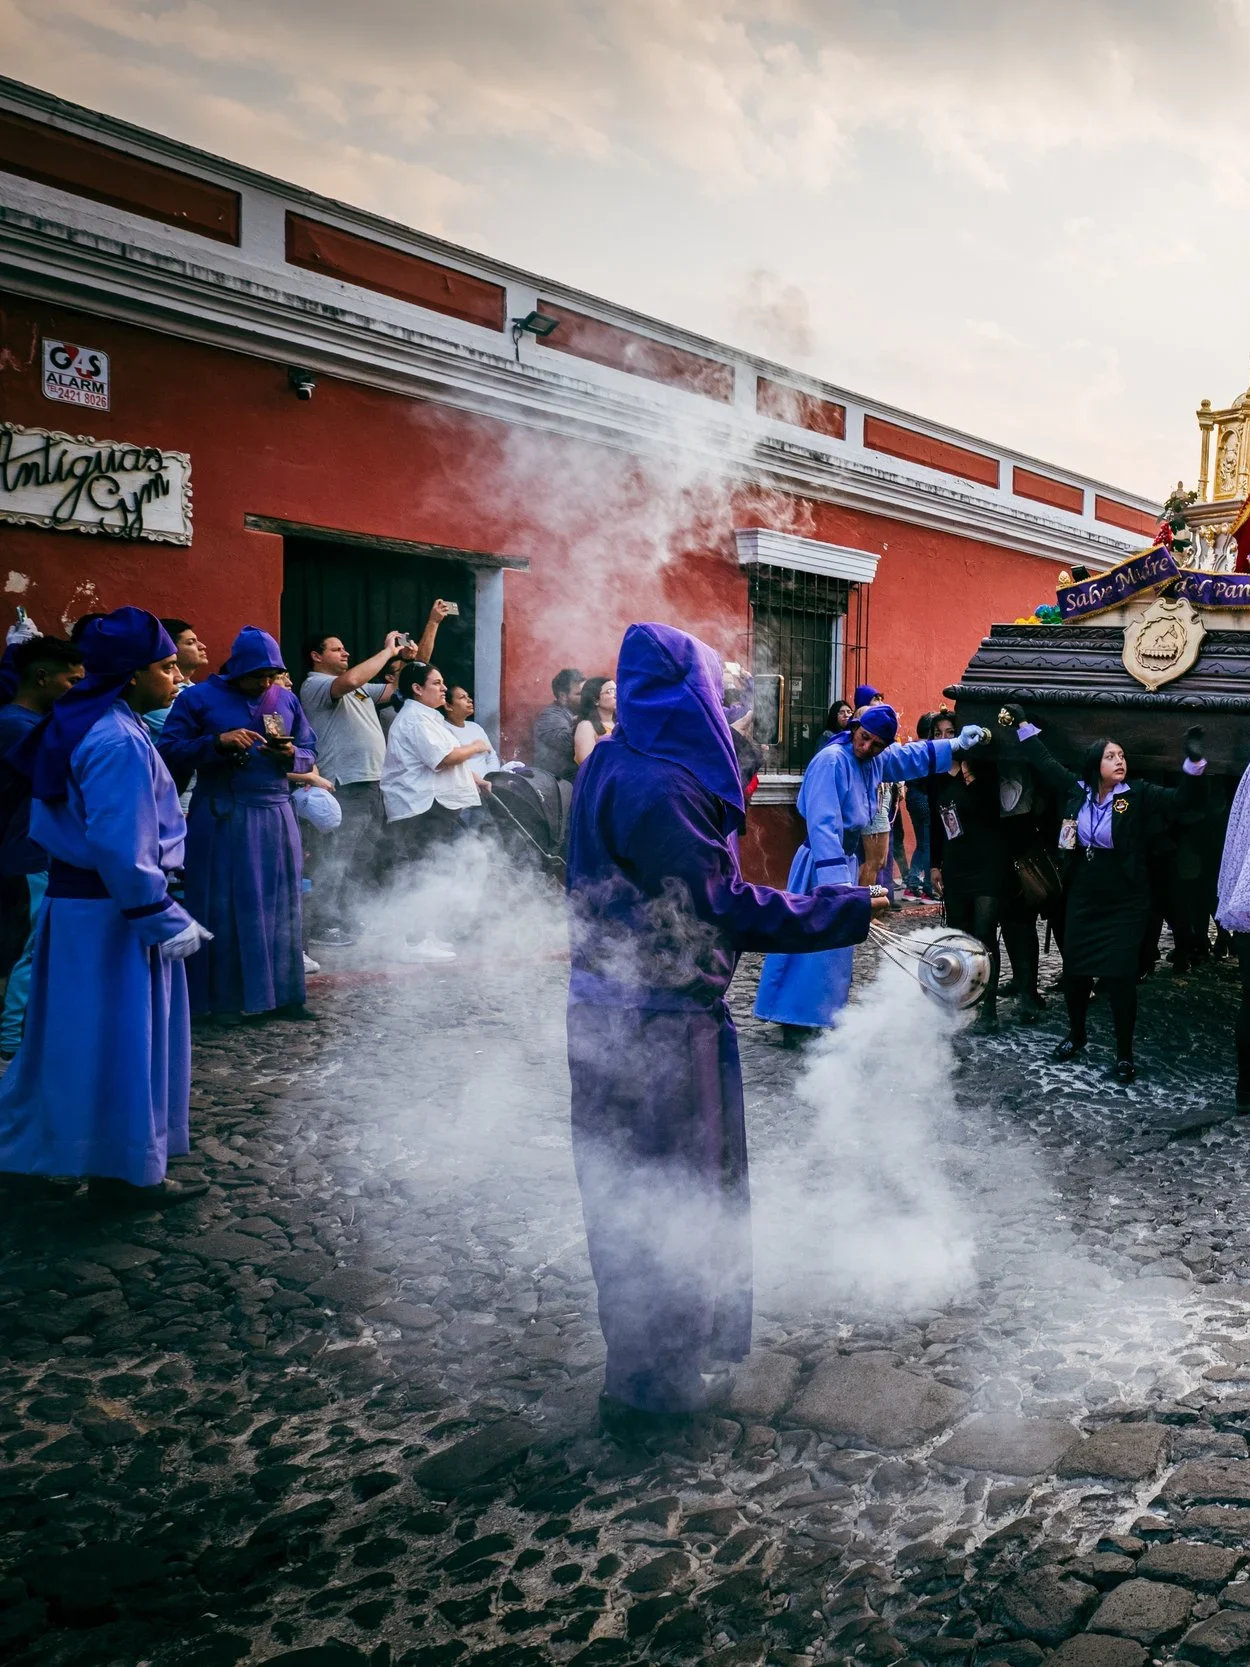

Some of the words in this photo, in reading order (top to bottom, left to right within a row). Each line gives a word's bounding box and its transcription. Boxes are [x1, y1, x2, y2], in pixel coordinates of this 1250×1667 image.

[47, 373, 104, 394] ALARM
[58, 388, 81, 402] 2421
[84, 393, 107, 407] 8026
[87, 472, 169, 538] Gym
[1066, 584, 1113, 611] Salve
